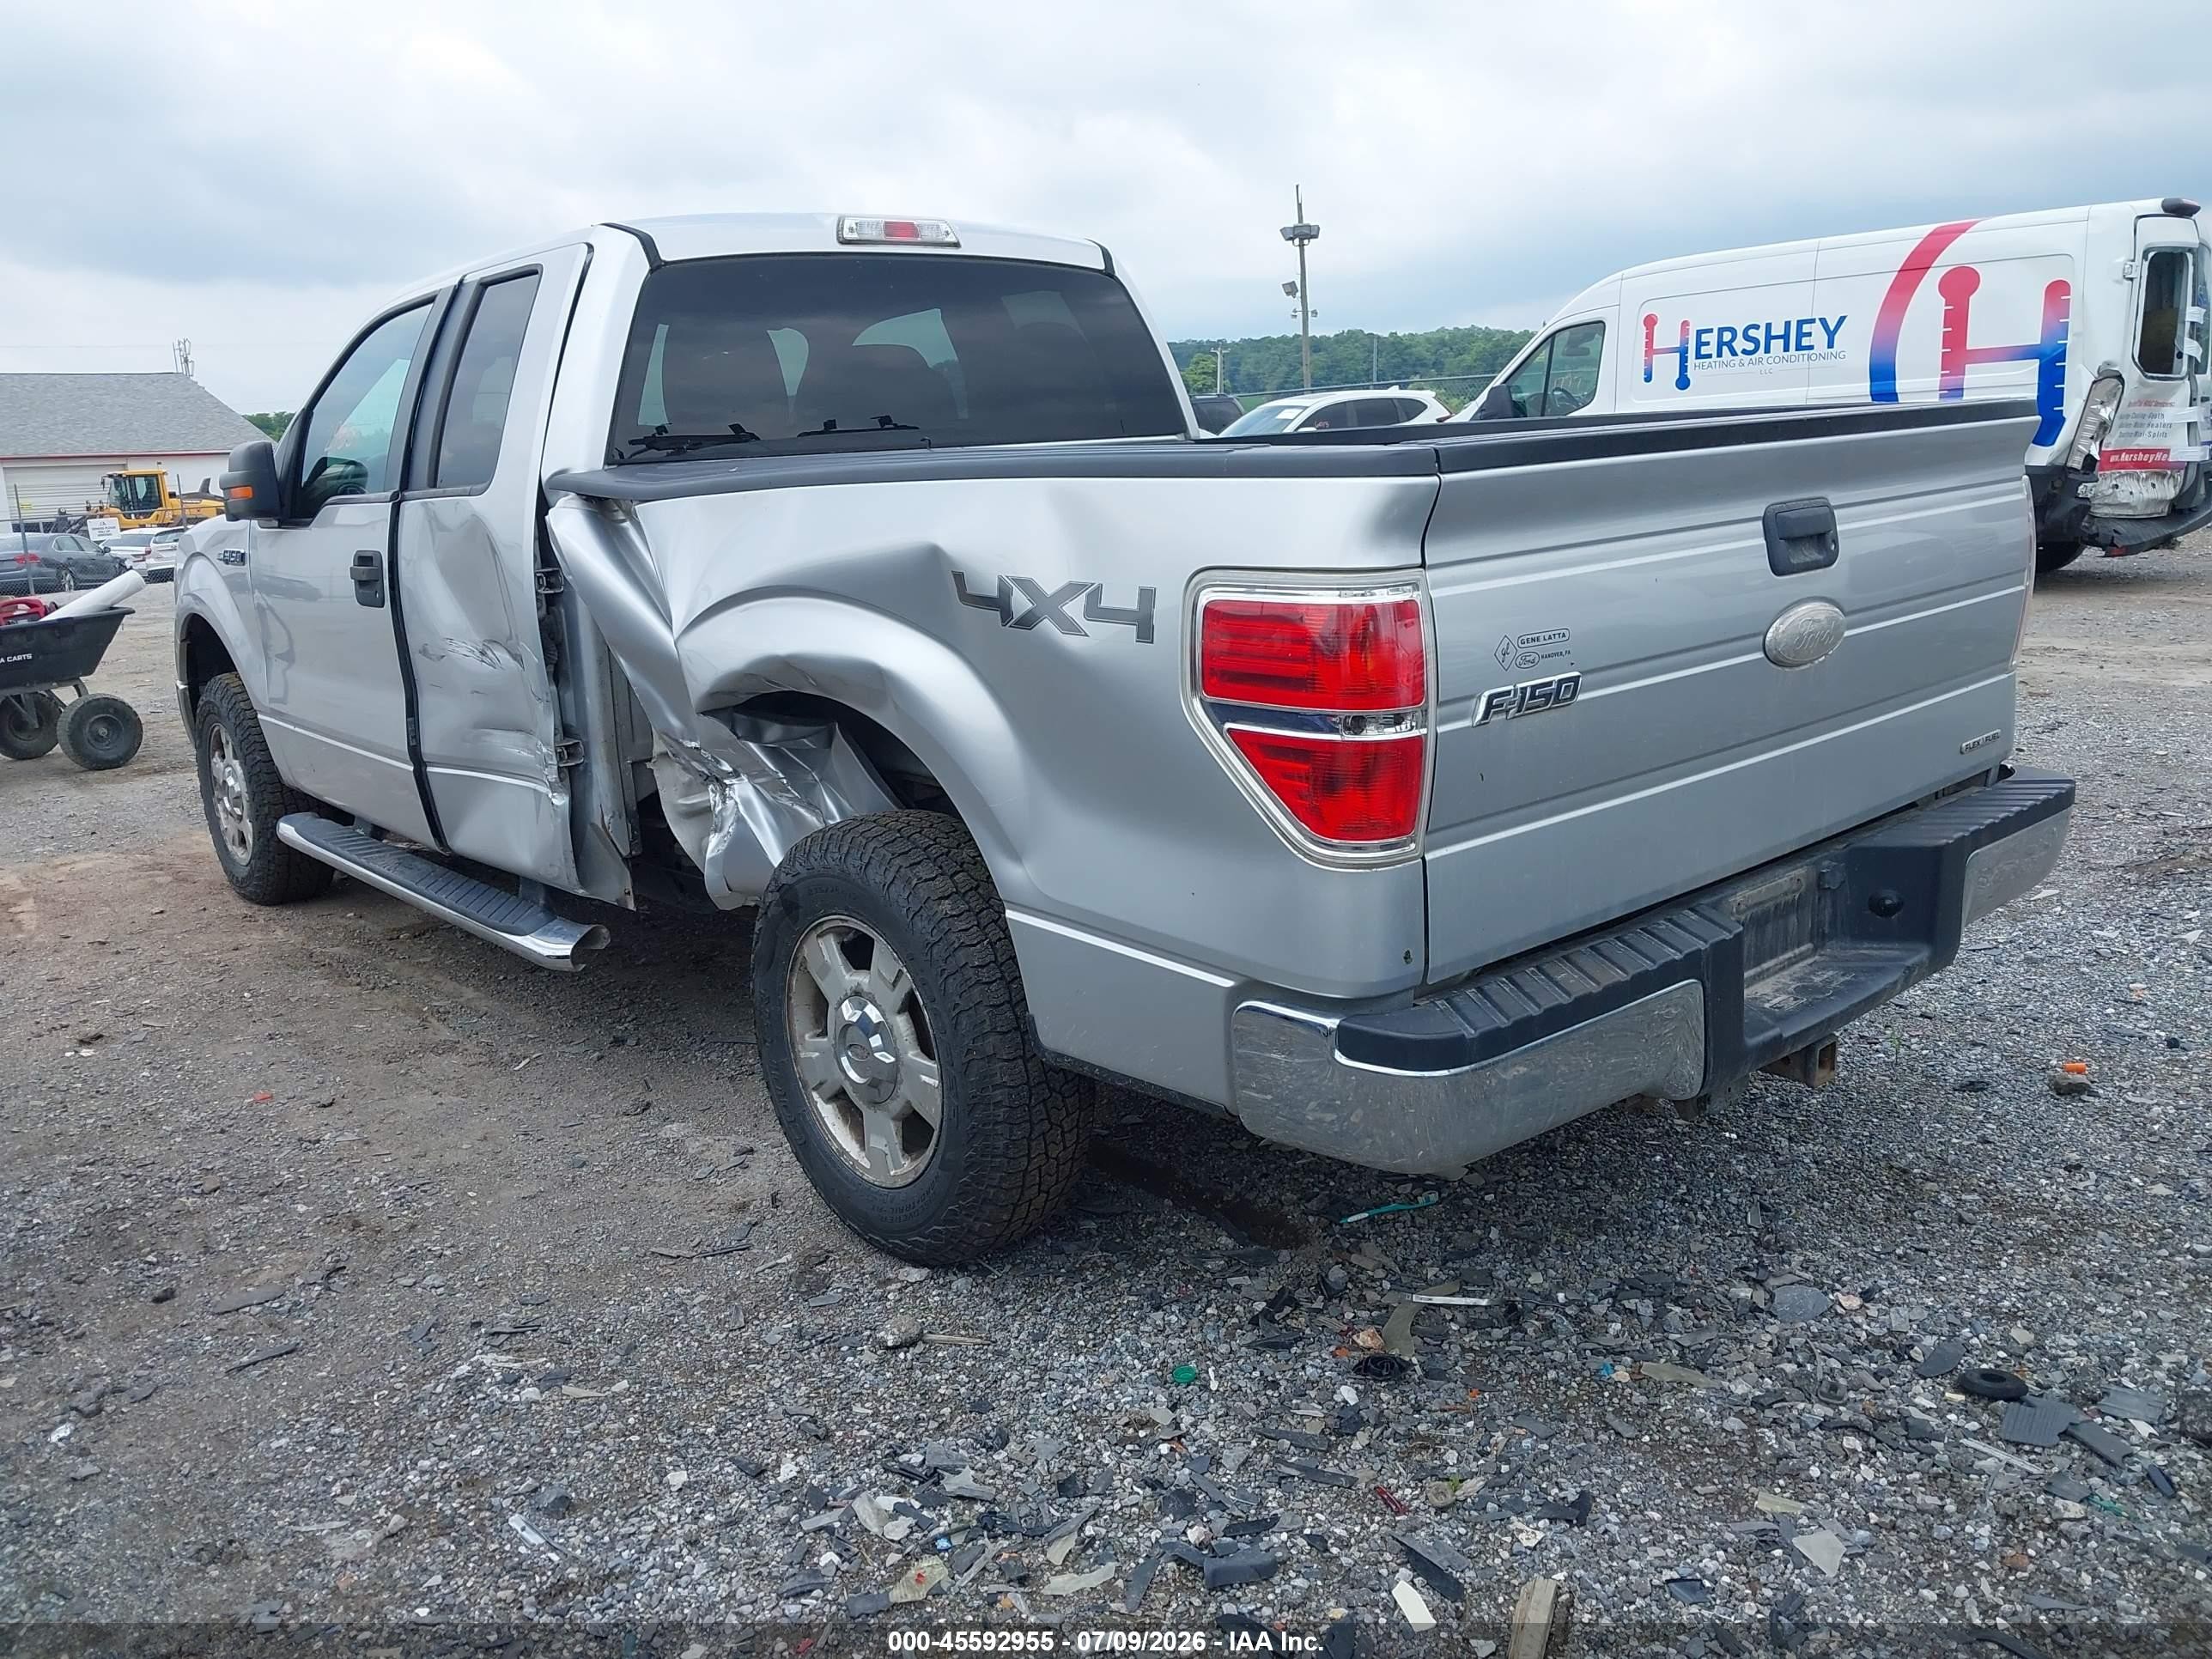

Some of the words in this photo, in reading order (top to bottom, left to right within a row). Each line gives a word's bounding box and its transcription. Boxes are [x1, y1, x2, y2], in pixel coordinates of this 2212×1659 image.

[1644, 313, 1848, 390] HERSHEY
[1694, 359, 1736, 371] HEATING
[1738, 358, 1746, 368] &
[1747, 357, 1764, 367] AIR
[1766, 350, 1846, 365] CONDITIONING
[951, 570, 1157, 644] 4X4
[1520, 636, 1540, 645] GENE
[1543, 632, 1566, 641] LATTA
[7, 653, 33, 662] CARTS
[1519, 654, 1536, 666] Ford
[1472, 672, 1582, 727] F-150
